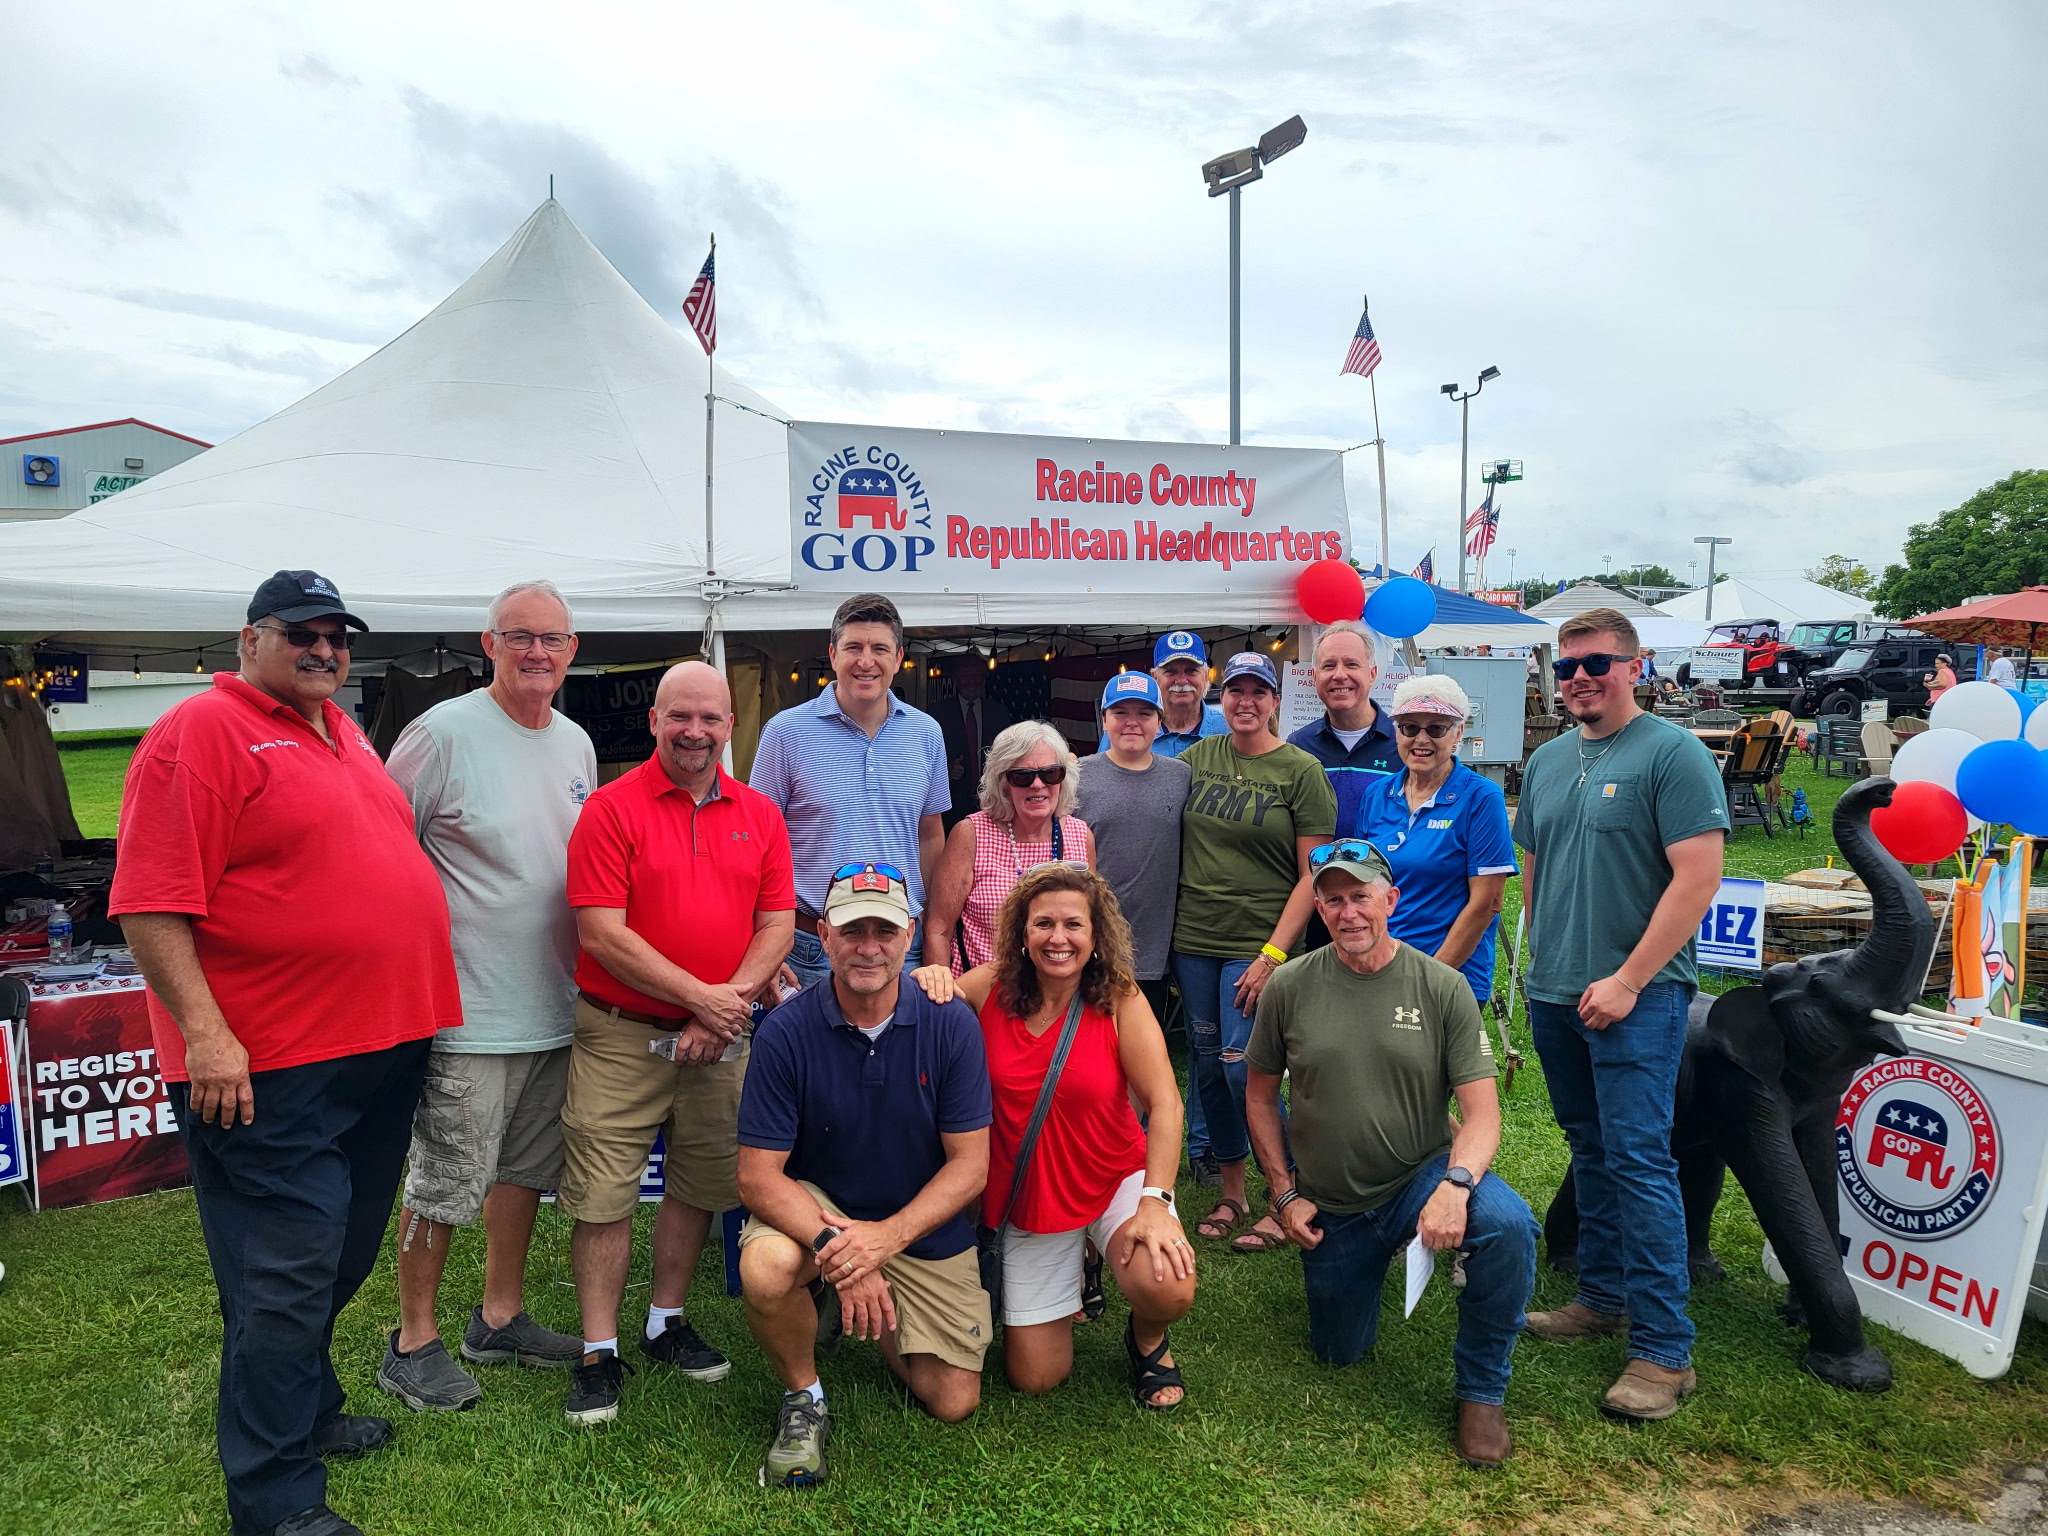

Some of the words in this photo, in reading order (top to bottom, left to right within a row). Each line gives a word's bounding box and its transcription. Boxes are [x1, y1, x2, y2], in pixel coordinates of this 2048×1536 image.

[804, 446, 860, 527] RACINE
[867, 446, 932, 530] COUNTY
[1036, 458, 1143, 506] Racine
[1149, 463, 1257, 517] County
[801, 532, 936, 573] GOP
[946, 514, 1128, 570] Republican
[1134, 519, 1343, 572] Headquarters
[1291, 668, 1305, 676] BIG
[1186, 780, 1279, 827] ARMY
[1241, 779, 1279, 792] STATES
[1391, 1023, 1422, 1031] FREEDOM
[36, 1049, 160, 1084] REGIST
[37, 1085, 90, 1113] TO
[1860, 1061, 1923, 1093] RACINE
[1928, 1066, 1987, 1126] COUNTY
[41, 1101, 180, 1151] HERE
[1882, 1132, 1922, 1156] GOP
[1838, 1149, 1920, 1231] REPUBLICAN
[1925, 1190, 1976, 1229] PARTY
[1862, 1240, 2000, 1328] OPEN
